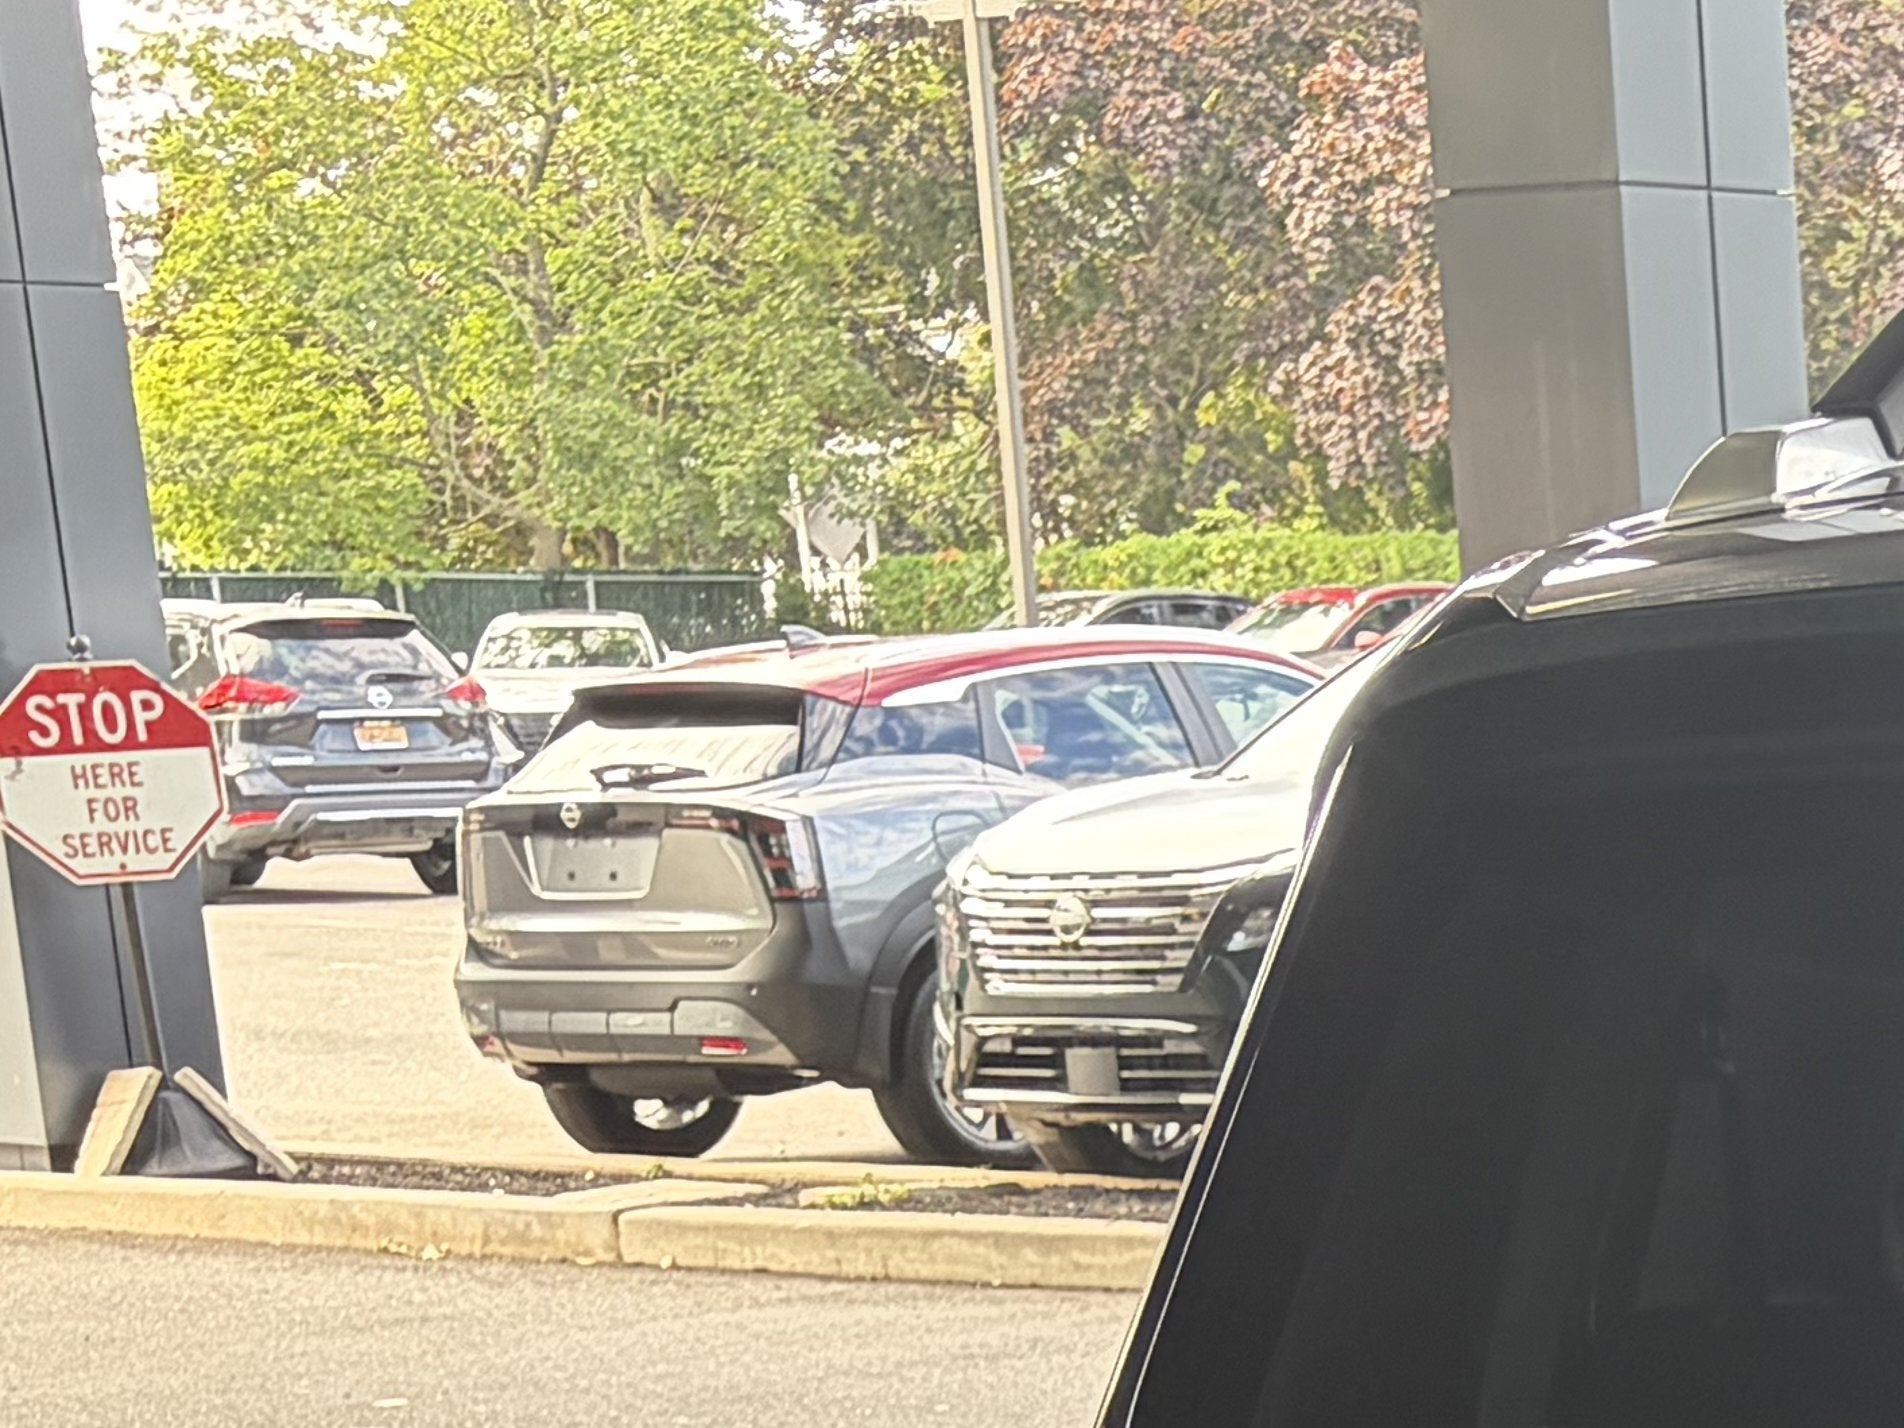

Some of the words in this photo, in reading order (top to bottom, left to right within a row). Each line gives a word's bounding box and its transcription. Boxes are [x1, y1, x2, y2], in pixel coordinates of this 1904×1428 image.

[25, 689, 165, 748] STOP
[70, 761, 144, 790] HERE
[86, 796, 140, 823] FOR
[62, 827, 176, 859] SERVICE
